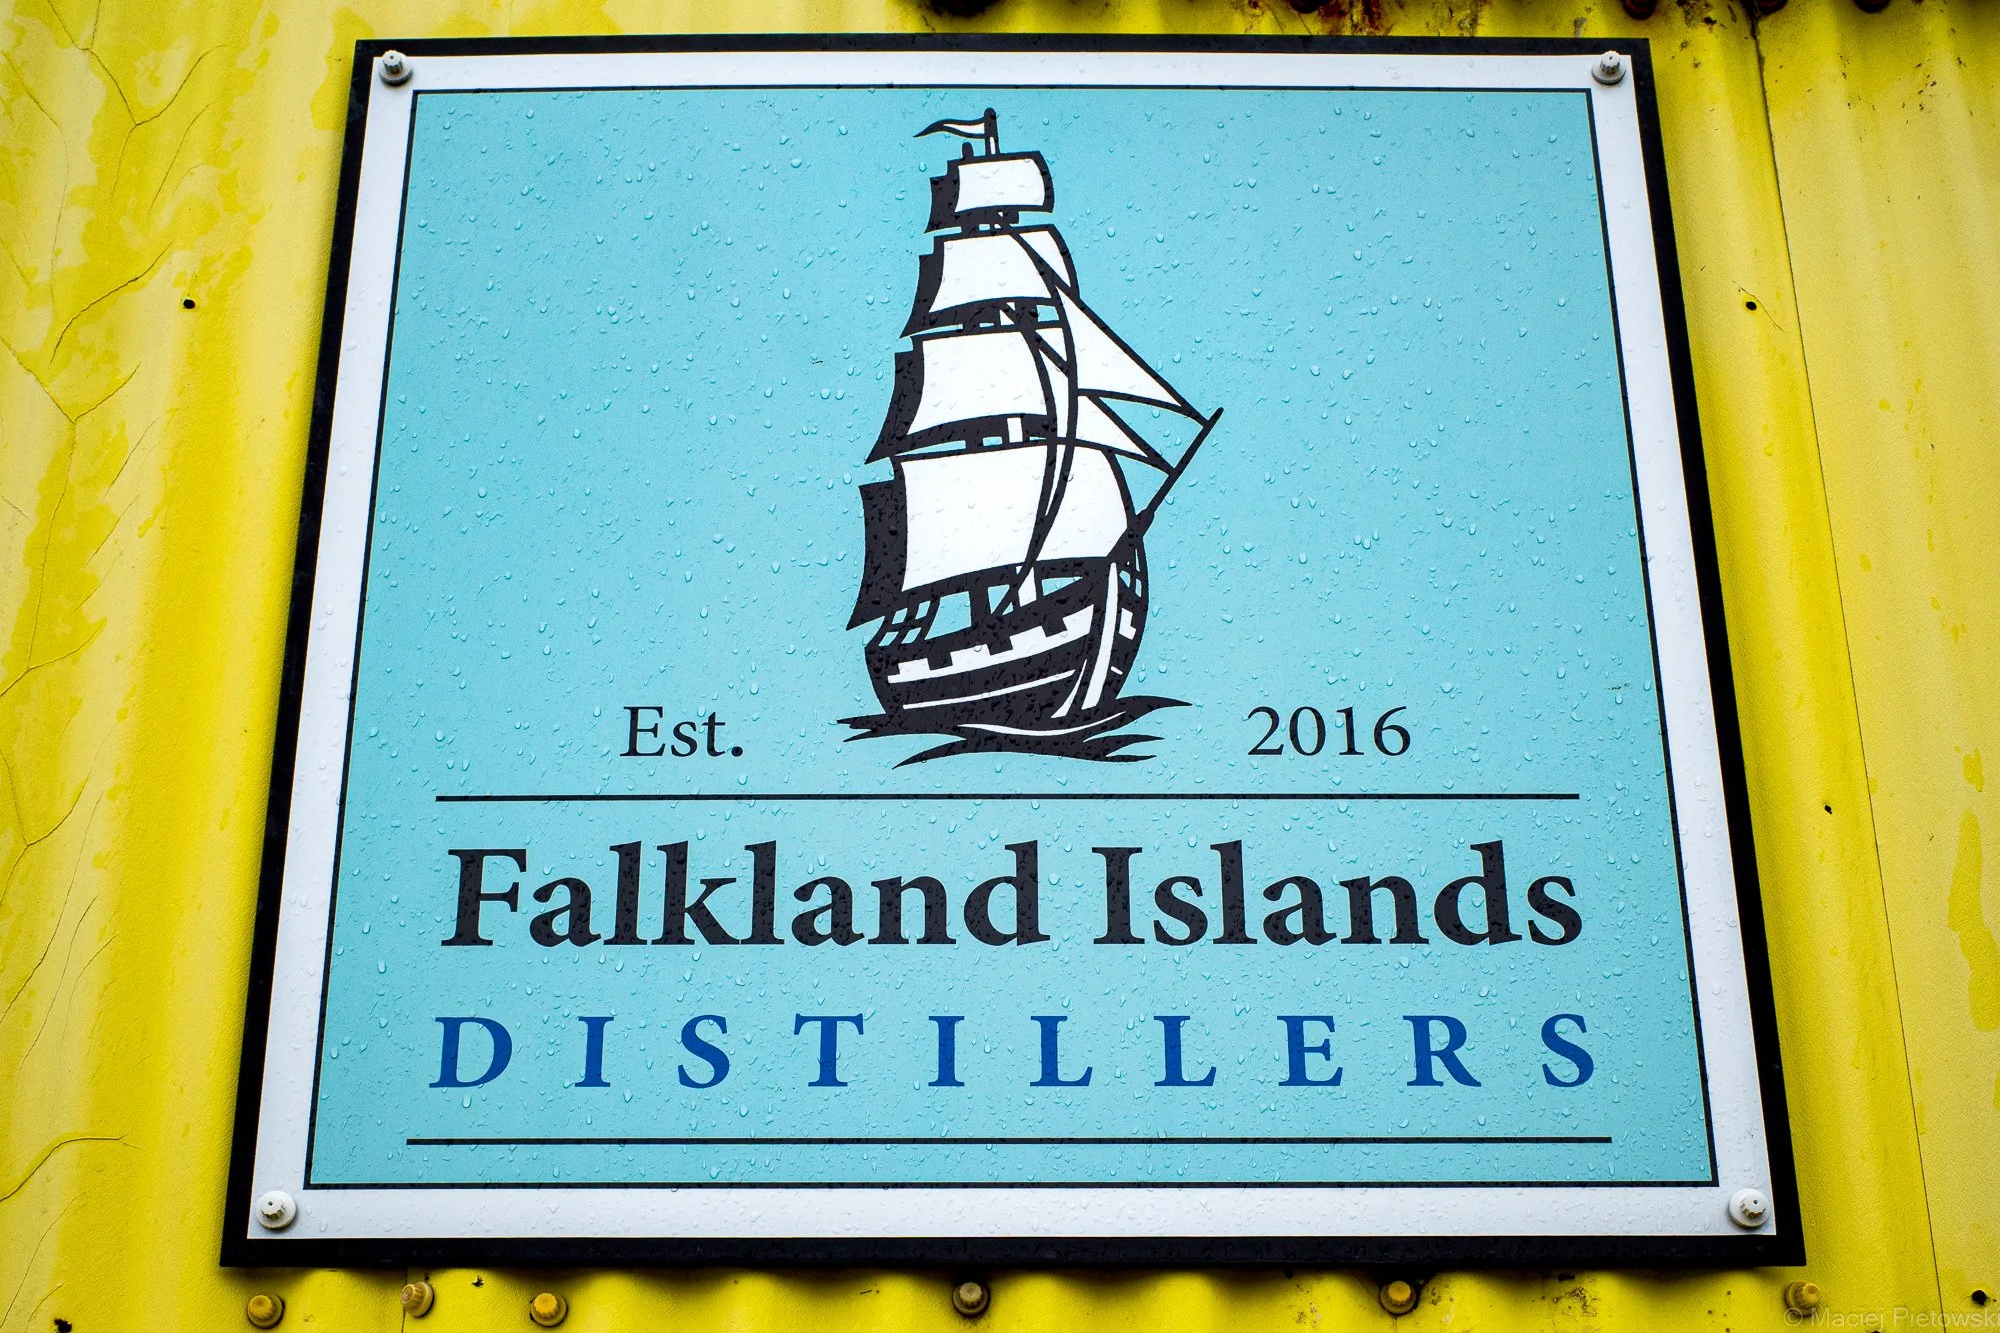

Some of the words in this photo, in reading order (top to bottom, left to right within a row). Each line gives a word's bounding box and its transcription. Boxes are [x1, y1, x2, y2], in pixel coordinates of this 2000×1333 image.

[620, 706, 744, 758] Est.
[1248, 705, 1410, 757] 2016
[441, 839, 1051, 948] Falkland
[1092, 839, 1583, 948] Islands
[429, 1012, 1597, 1090] DISTILLERS
